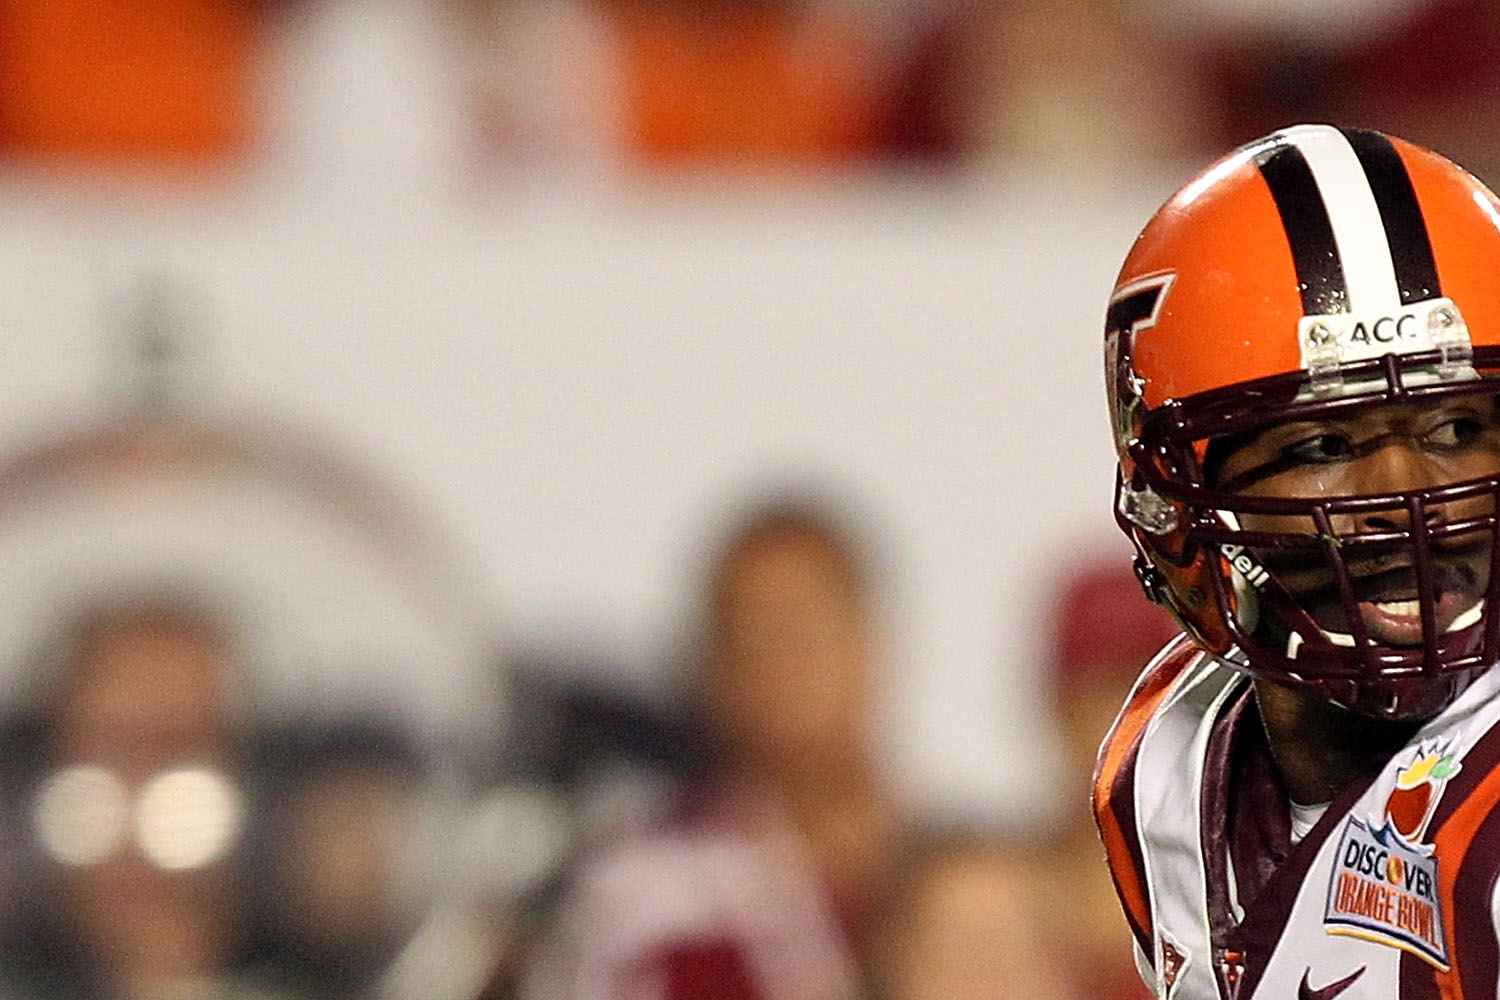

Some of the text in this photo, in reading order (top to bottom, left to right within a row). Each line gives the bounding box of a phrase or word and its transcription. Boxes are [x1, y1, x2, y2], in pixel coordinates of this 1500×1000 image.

[1351, 314, 1417, 345] ACC
[1344, 839, 1435, 903] DISCOVER
[1335, 870, 1442, 951] ORANGE BOWL
